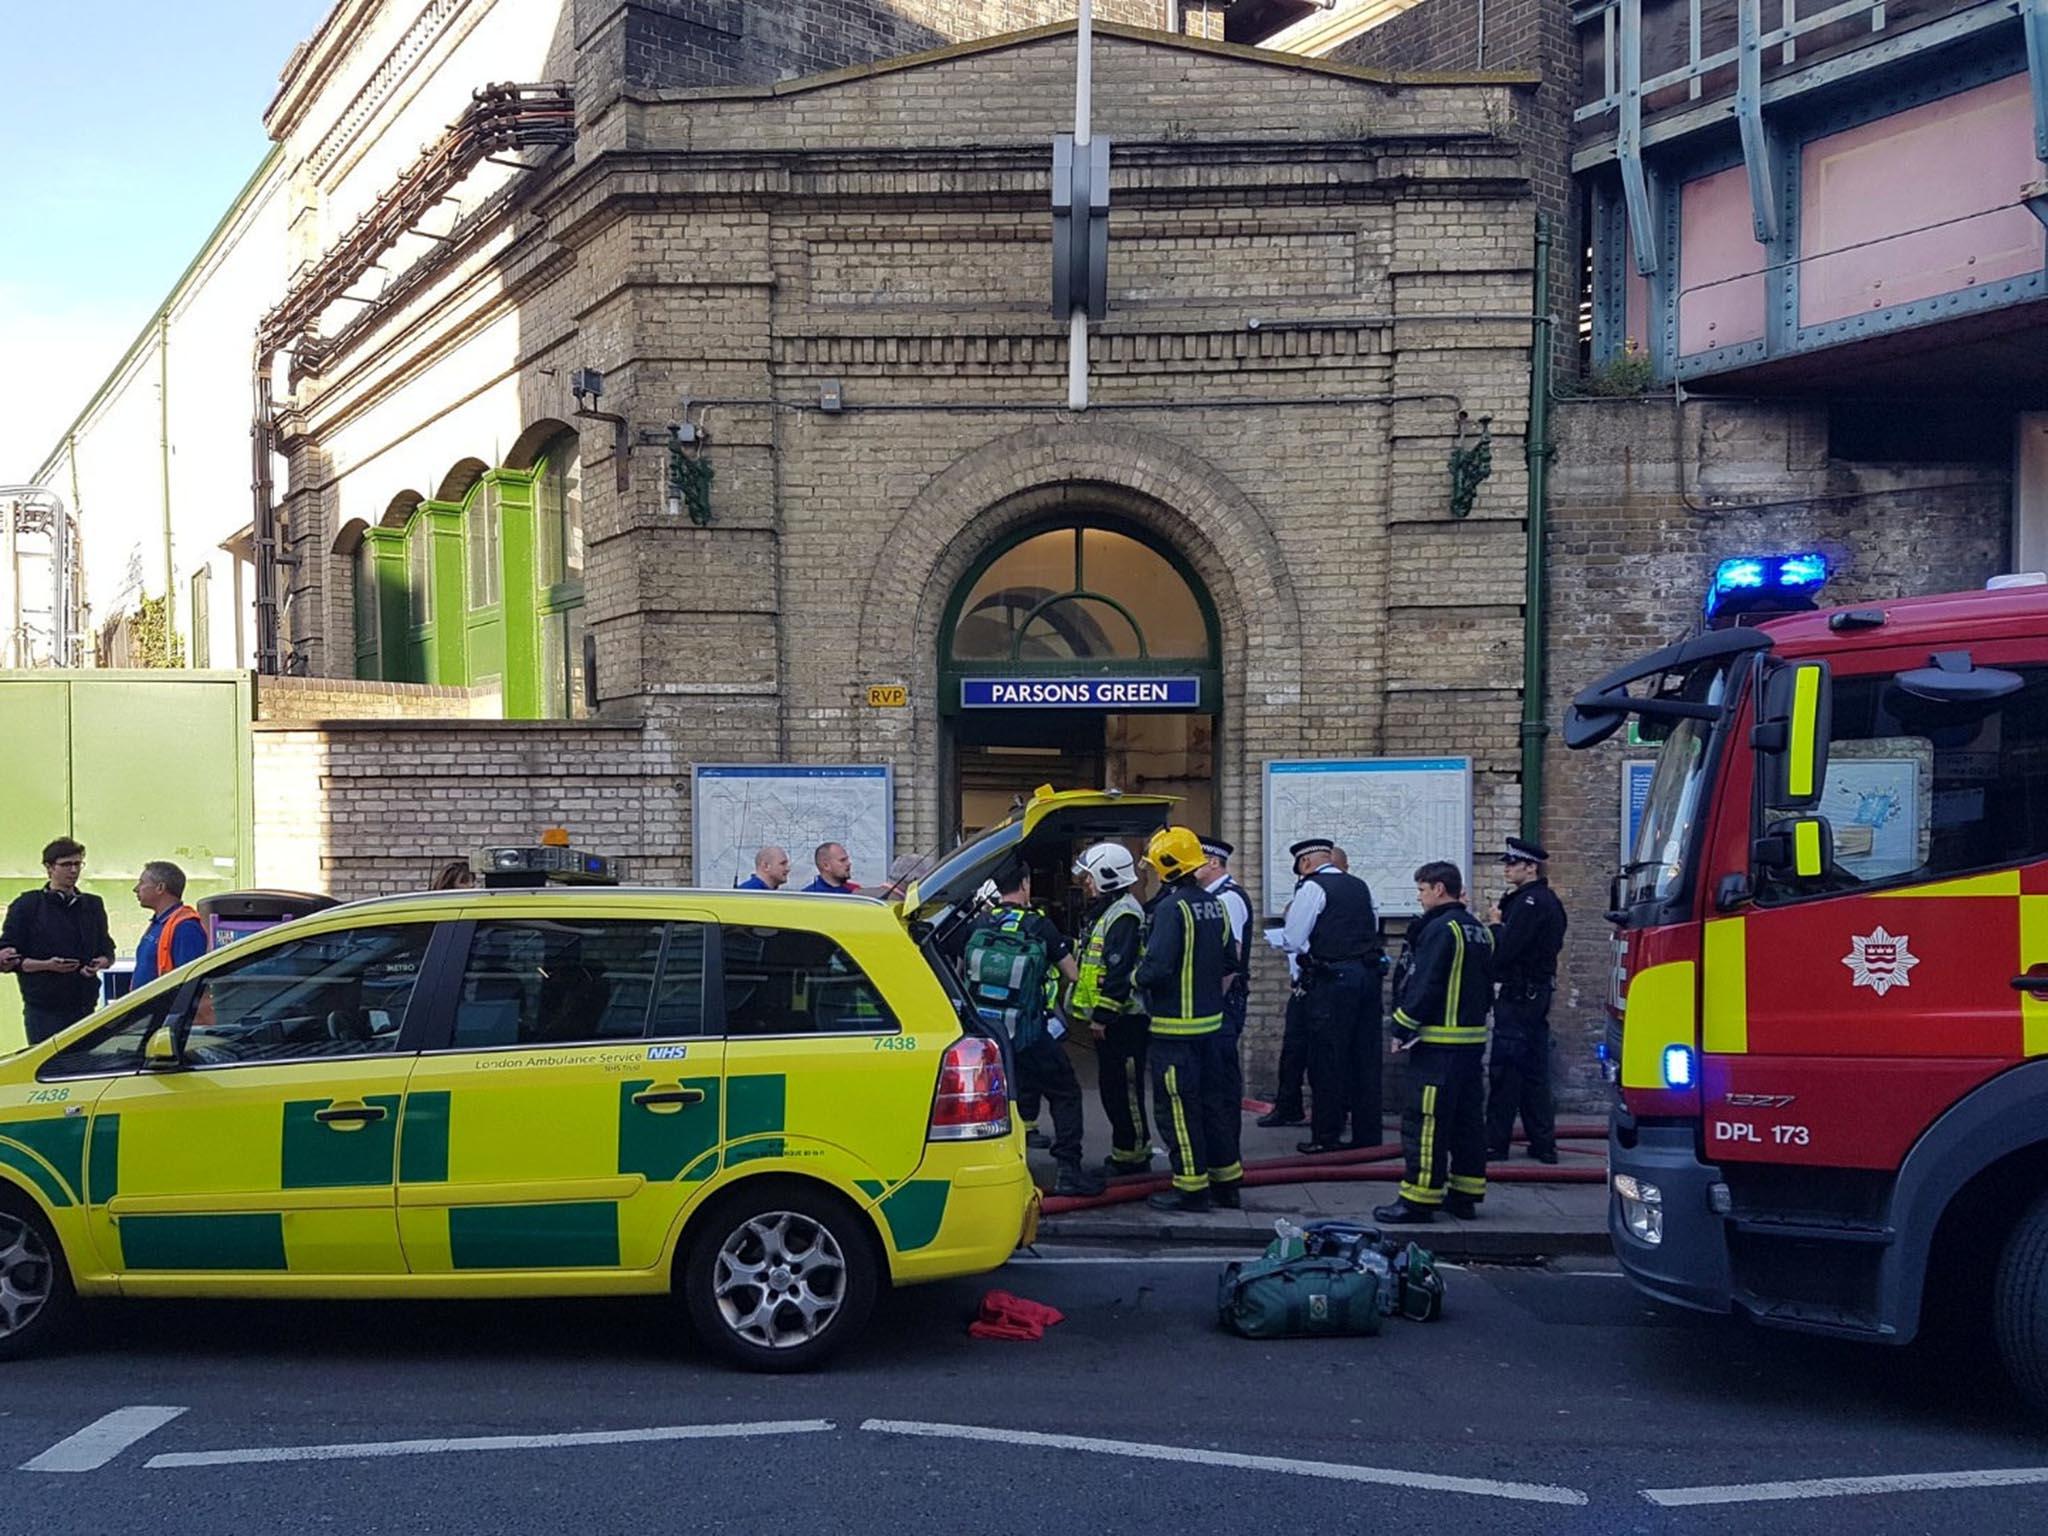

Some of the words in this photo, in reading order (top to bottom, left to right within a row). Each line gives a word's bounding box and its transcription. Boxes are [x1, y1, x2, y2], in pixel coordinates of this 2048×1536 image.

[871, 689, 903, 703] RVP
[991, 684, 1091, 702] PARSONS
[1095, 683, 1169, 701] GREEN
[873, 1036, 917, 1051] 7438
[475, 1058, 524, 1070] London
[526, 1055, 597, 1067] Ambulance
[599, 1052, 643, 1063] Service
[648, 1046, 686, 1060] NHS
[27, 1087, 71, 1104] 7438
[1715, 1121, 1763, 1143] DPL
[1770, 1124, 1810, 1145] 173
